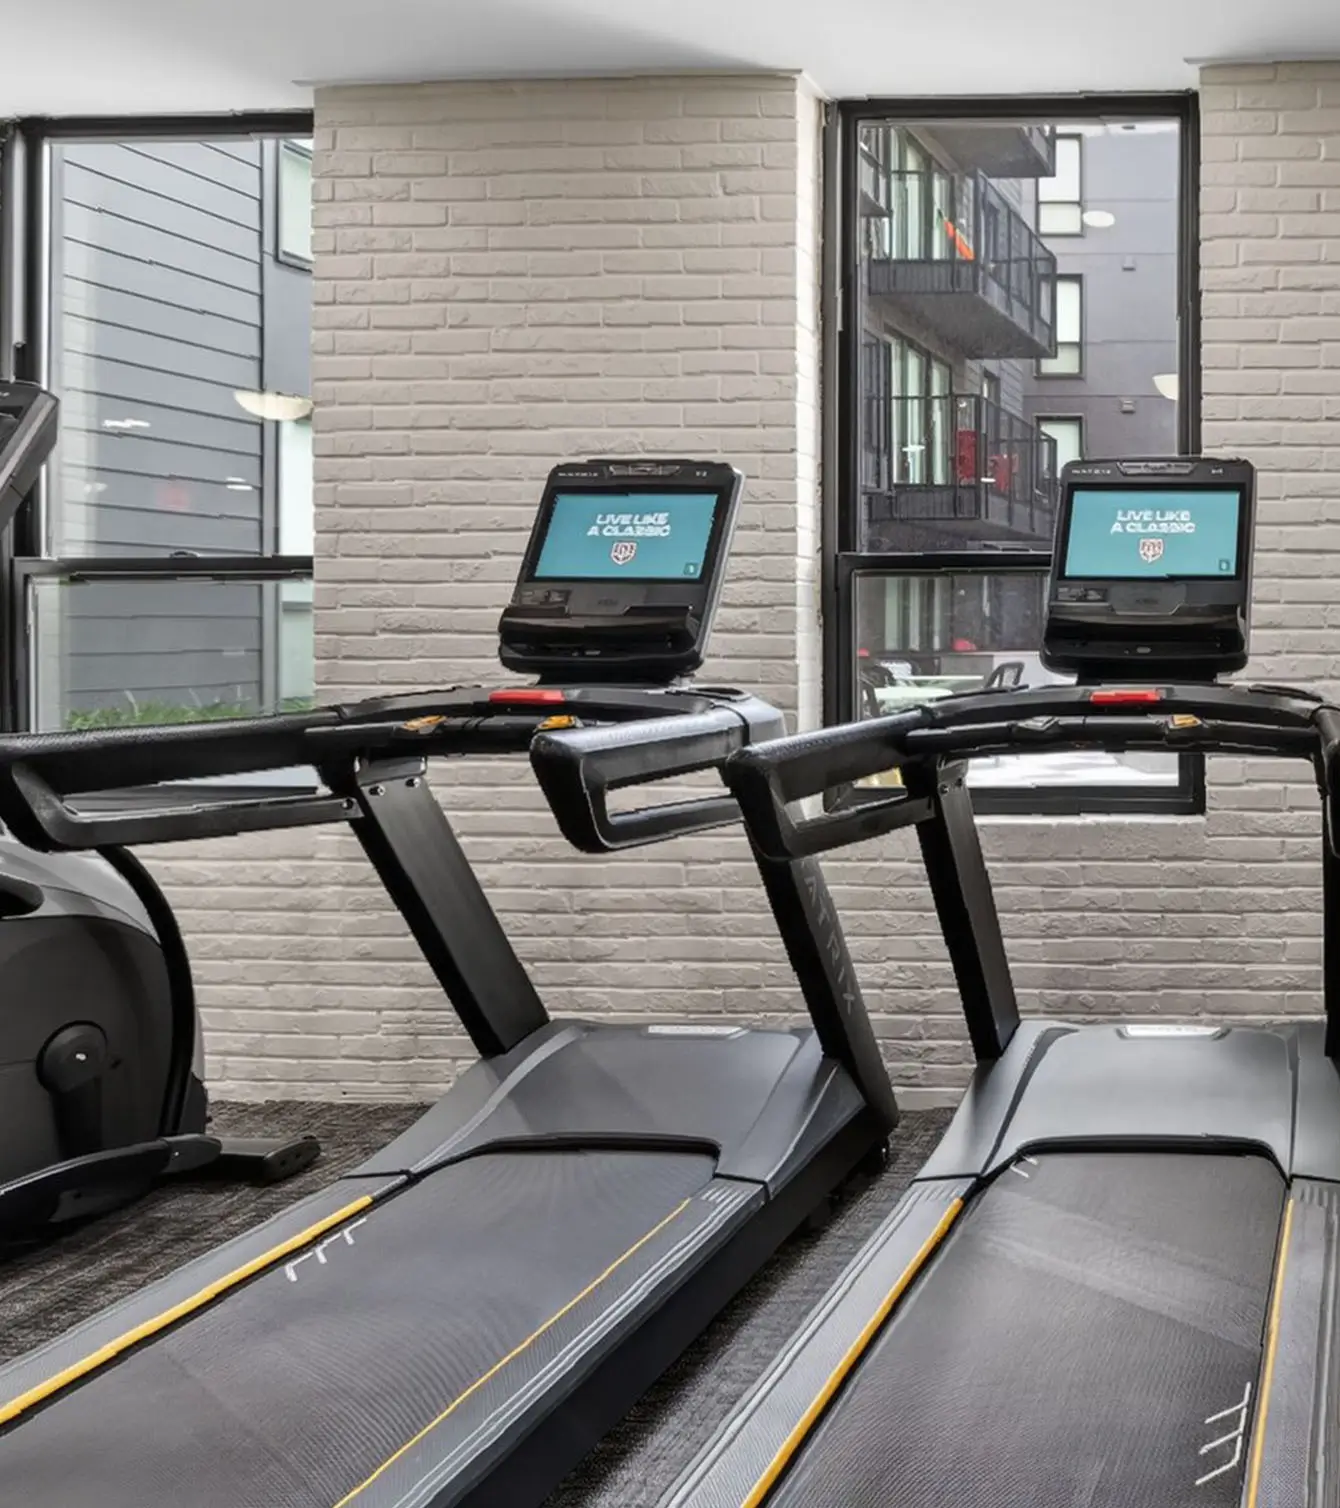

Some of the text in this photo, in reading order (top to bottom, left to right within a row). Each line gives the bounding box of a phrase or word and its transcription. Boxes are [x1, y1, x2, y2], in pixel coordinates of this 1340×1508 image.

[596, 512, 669, 525] LIVE LIKE
[1116, 510, 1191, 521] LIVE LIKE
[587, 524, 671, 537] A CLASSIC
[1110, 522, 1196, 535] A CLASSIC
